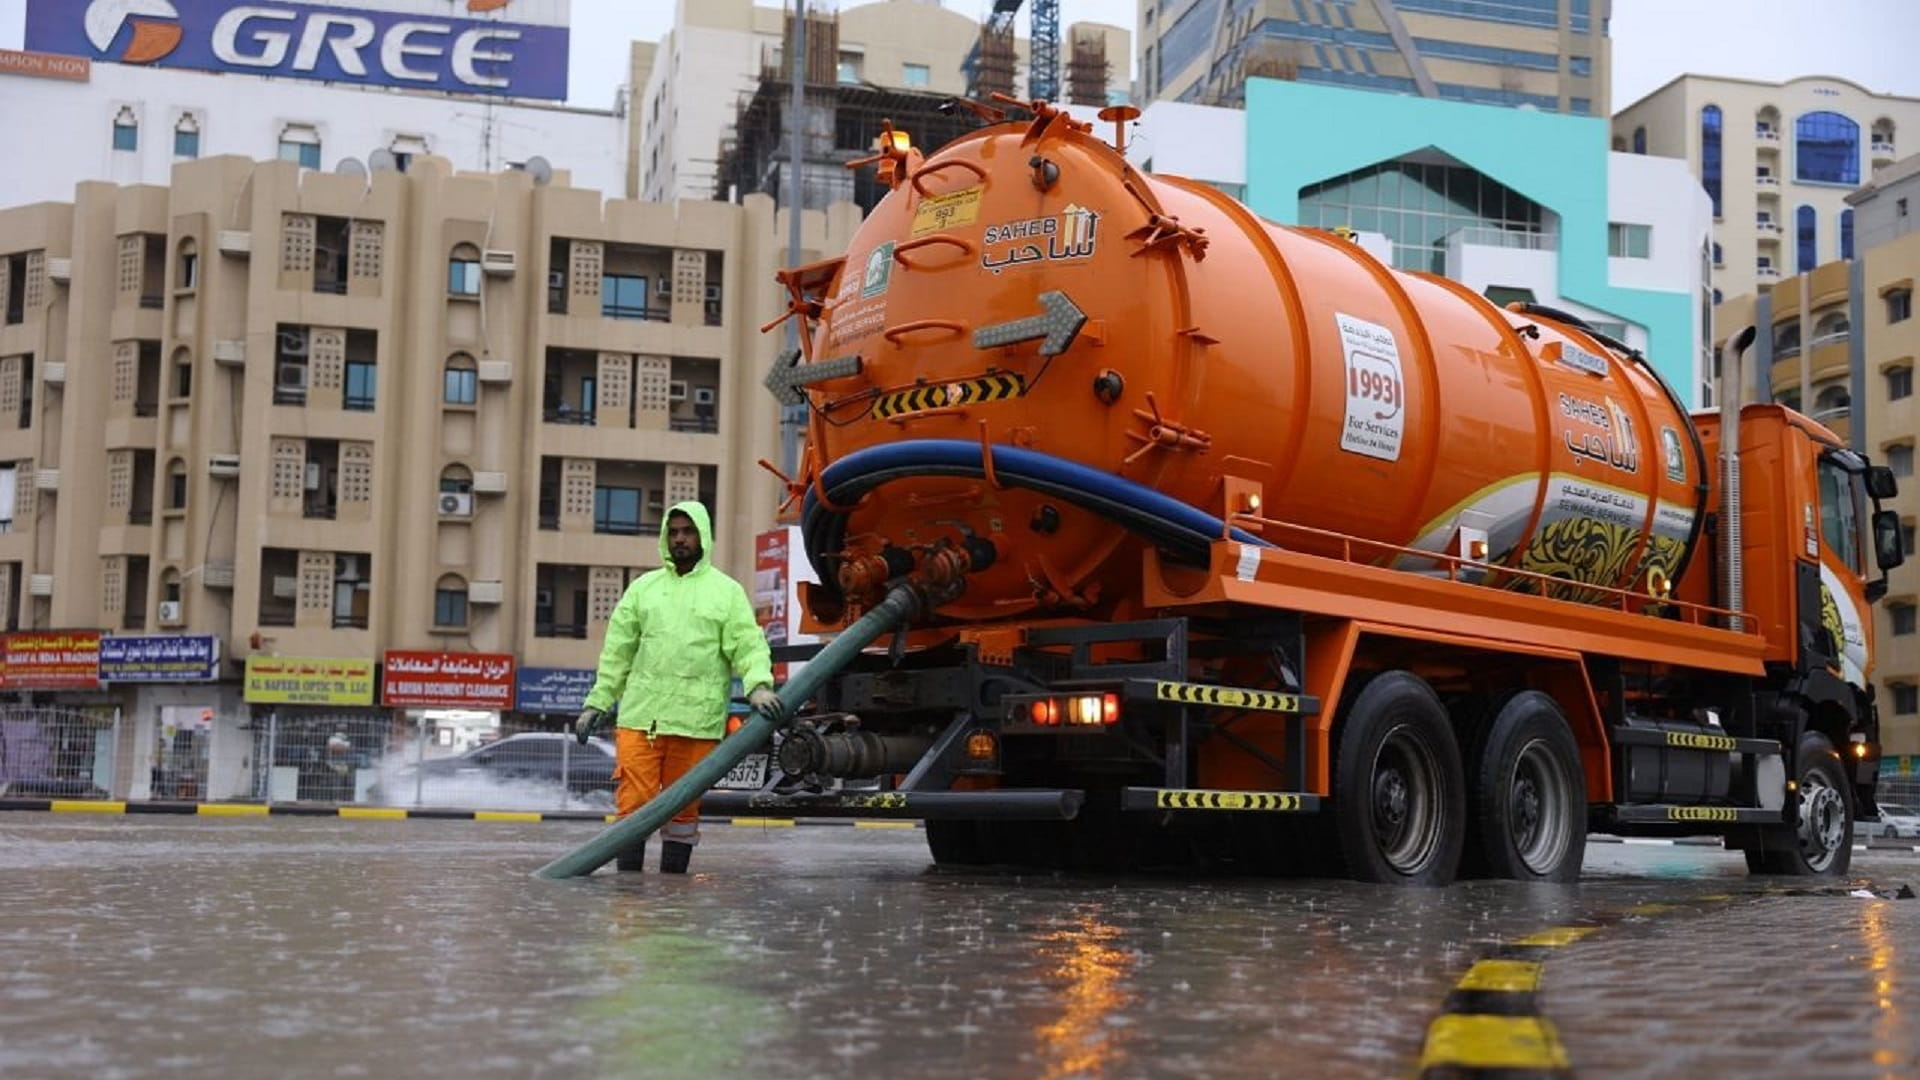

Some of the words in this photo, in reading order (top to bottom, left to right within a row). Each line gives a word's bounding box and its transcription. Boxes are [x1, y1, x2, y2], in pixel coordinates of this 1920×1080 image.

[212, 6, 521, 88] GREE
[47, 59, 86, 73] NEON
[984, 218, 1057, 244] SAHEB
[982, 222, 1096, 273] ساحب
[1360, 368, 1394, 405] 993
[1559, 392, 1610, 431] SAHEB
[1348, 415, 1364, 430] For
[1365, 421, 1398, 438] Services
[1564, 424, 1637, 475] ساحب
[387, 657, 440, 674] المعاملات
[441, 654, 482, 679] لمتابعة
[483, 660, 510, 680] الريان
[386, 681, 397, 695] AL
[424, 682, 465, 698] DOCUMENT
[466, 683, 508, 699] CLEARANCE
